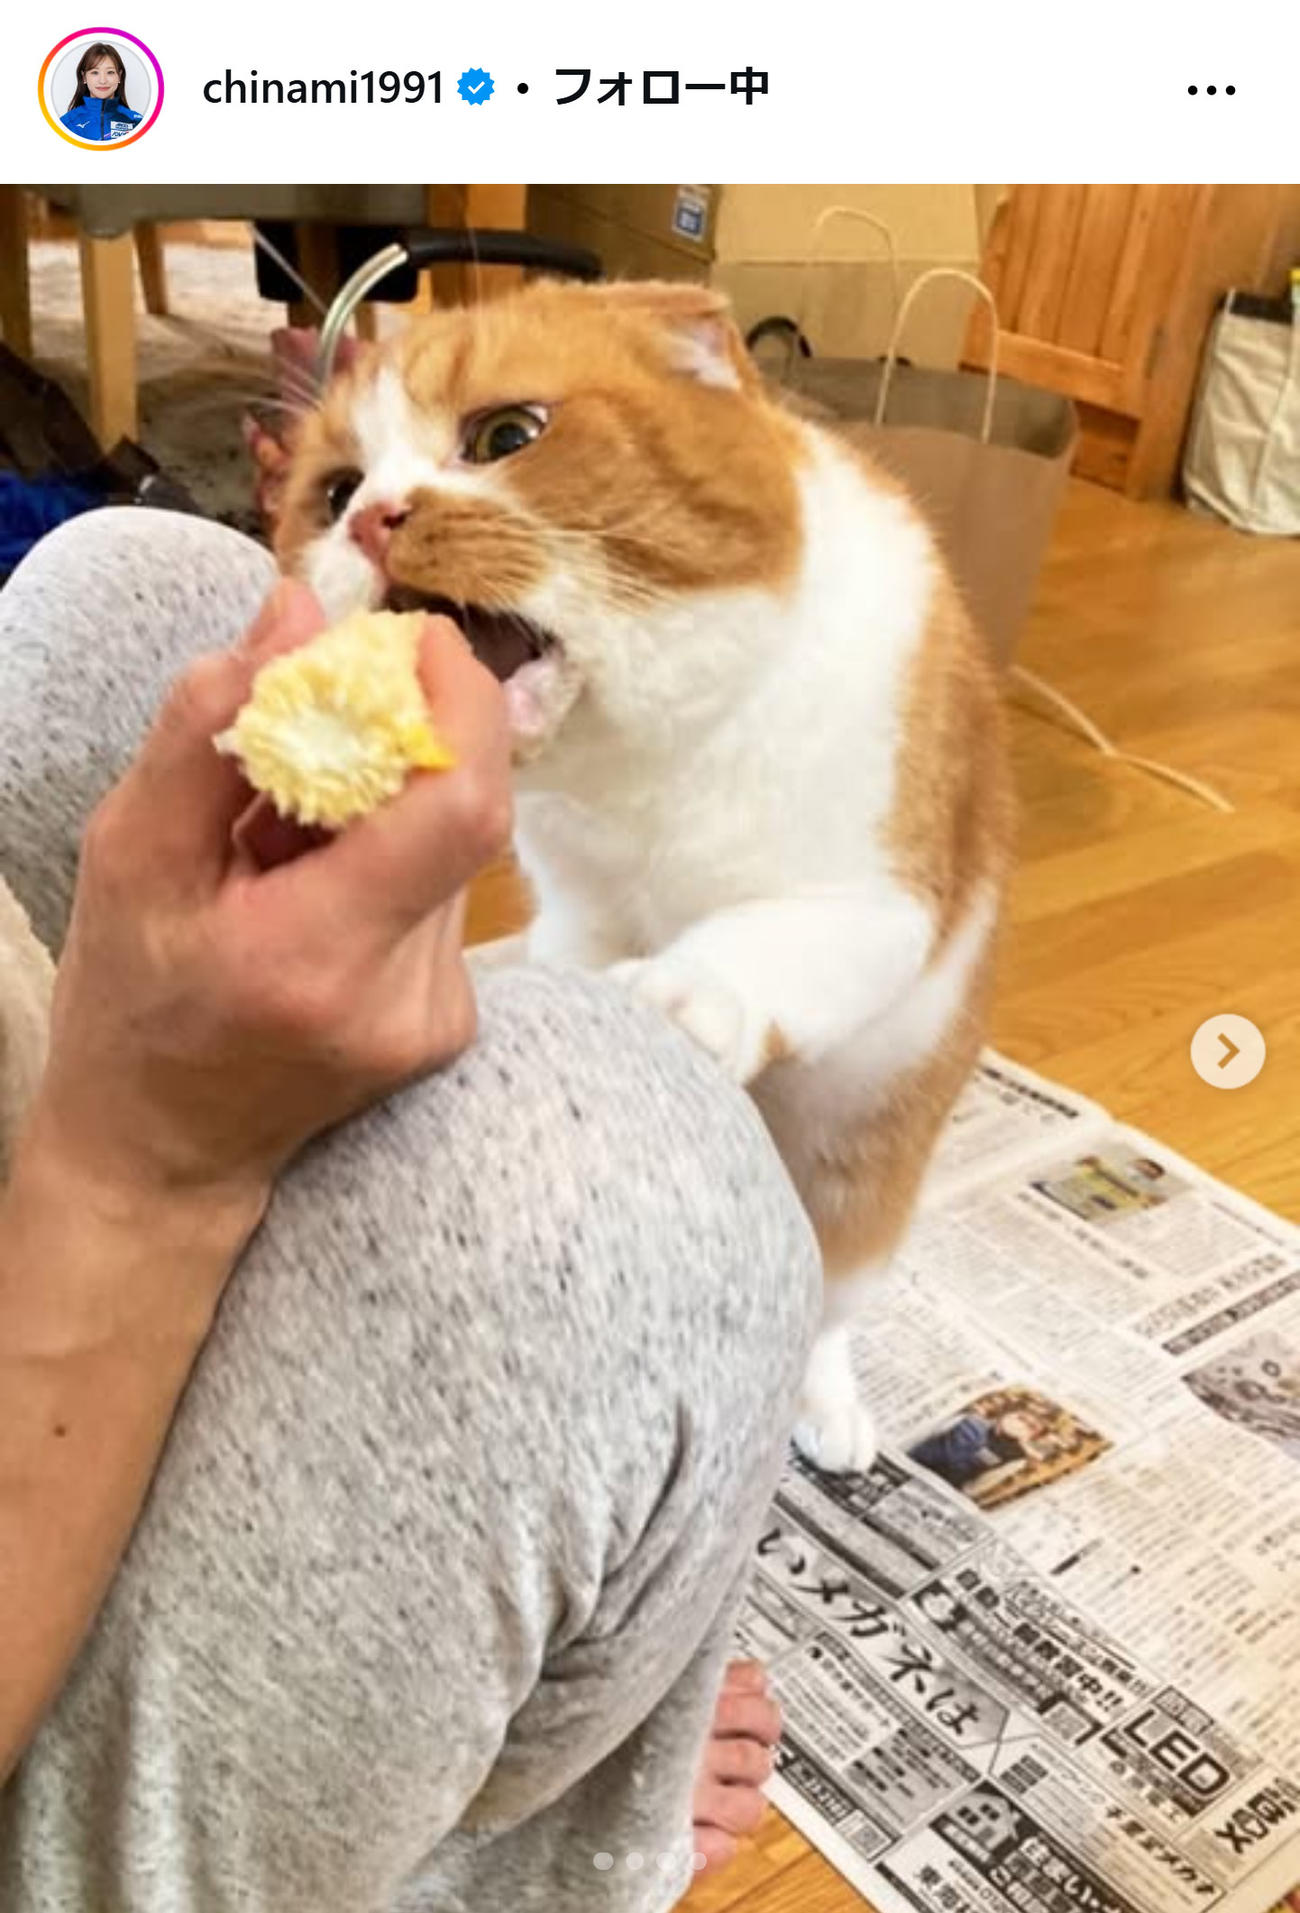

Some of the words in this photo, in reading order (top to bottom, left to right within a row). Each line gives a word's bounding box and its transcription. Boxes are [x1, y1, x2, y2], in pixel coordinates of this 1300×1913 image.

[757, 1528, 979, 1735] いメガネは
[1123, 1708, 1231, 1797] LED
